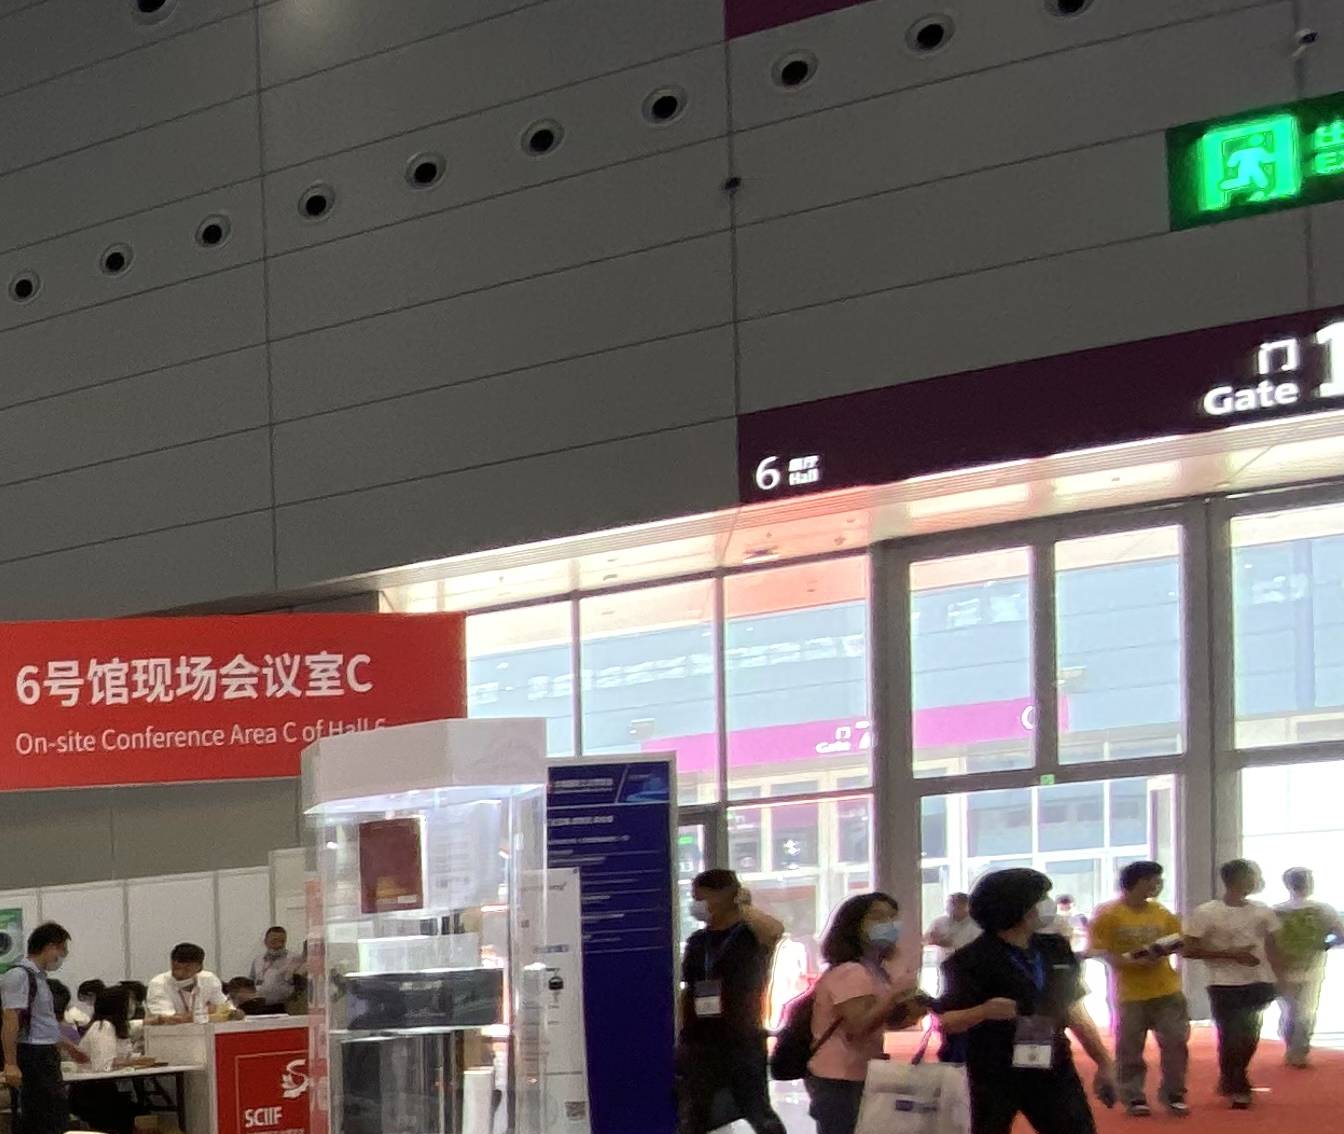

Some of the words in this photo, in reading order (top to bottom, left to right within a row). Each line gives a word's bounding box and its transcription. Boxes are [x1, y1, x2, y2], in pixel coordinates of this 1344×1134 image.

[1203, 380, 1299, 415] Gate
[1316, 321, 1344, 397] 1
[1258, 338, 1298, 374] 门
[756, 455, 781, 490] 6
[15, 650, 374, 708] 6号馆现场会议室C
[15, 730, 96, 755] On-site
[101, 725, 226, 751] Conference
[230, 723, 277, 746] Area
[282, 721, 298, 743] C
[302, 719, 324, 743] of
[244, 1105, 283, 1129] SCIIF
